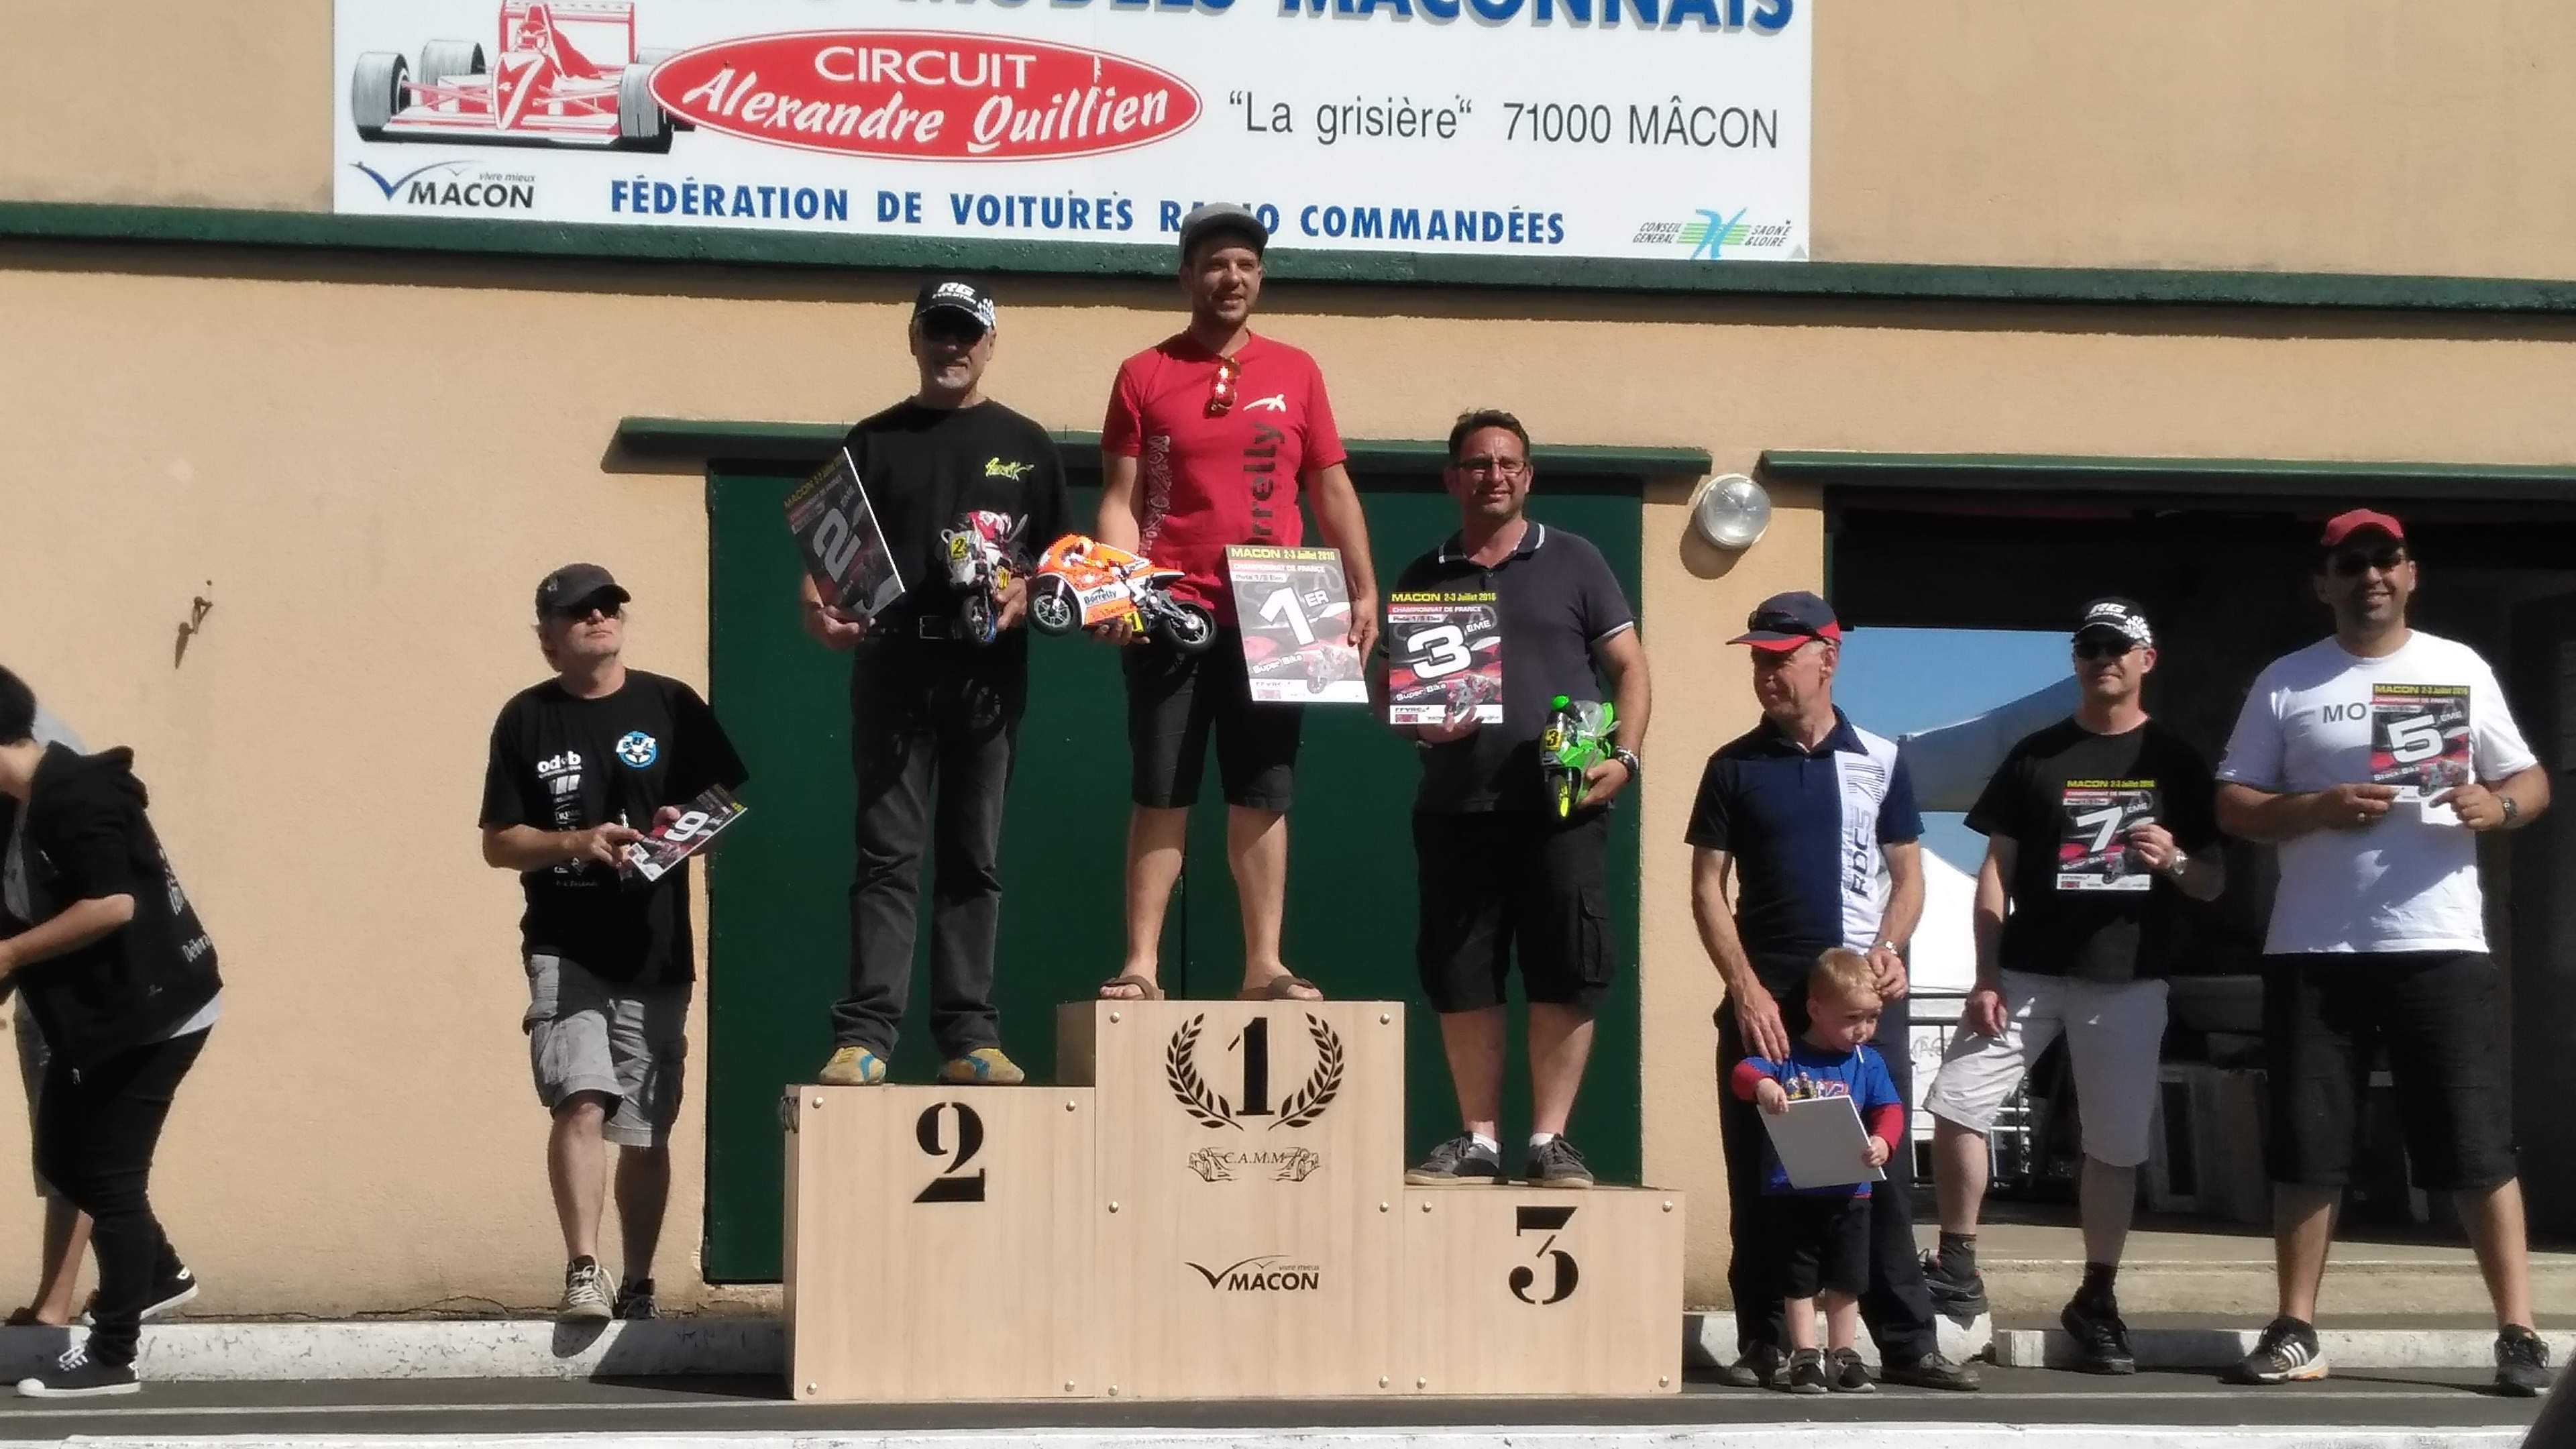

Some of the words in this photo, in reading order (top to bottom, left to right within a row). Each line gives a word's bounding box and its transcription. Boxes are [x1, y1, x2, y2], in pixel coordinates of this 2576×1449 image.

[814, 46, 1036, 88] CIRCUIT
[682, 68, 945, 143] Alexandre
[967, 86, 1168, 153] Quillien
[1503, 102, 1611, 144] 71000
[1629, 96, 1778, 149] MÂCON
[611, 174, 848, 221] FÉDÉRATION
[877, 190, 922, 223] DE
[950, 193, 1133, 231] VOITURES
[1300, 205, 1564, 244] COMMANDÉES
[1633, 233, 1675, 244] GENERAL
[1640, 223, 1682, 233] CONSEIL
[812, 508, 861, 582] 2
[1231, 548, 1281, 559] MACON
[1391, 593, 1440, 602] MACON
[1407, 625, 1472, 679] 3
[1546, 729, 1558, 747] 3
[2387, 714, 2443, 763] 5
[664, 811, 710, 842] 9
[2076, 806, 2123, 853] 7
[1228, 1017, 1275, 1116] 1
[912, 1102, 985, 1203] 2
[1509, 1205, 1579, 1305] 3
